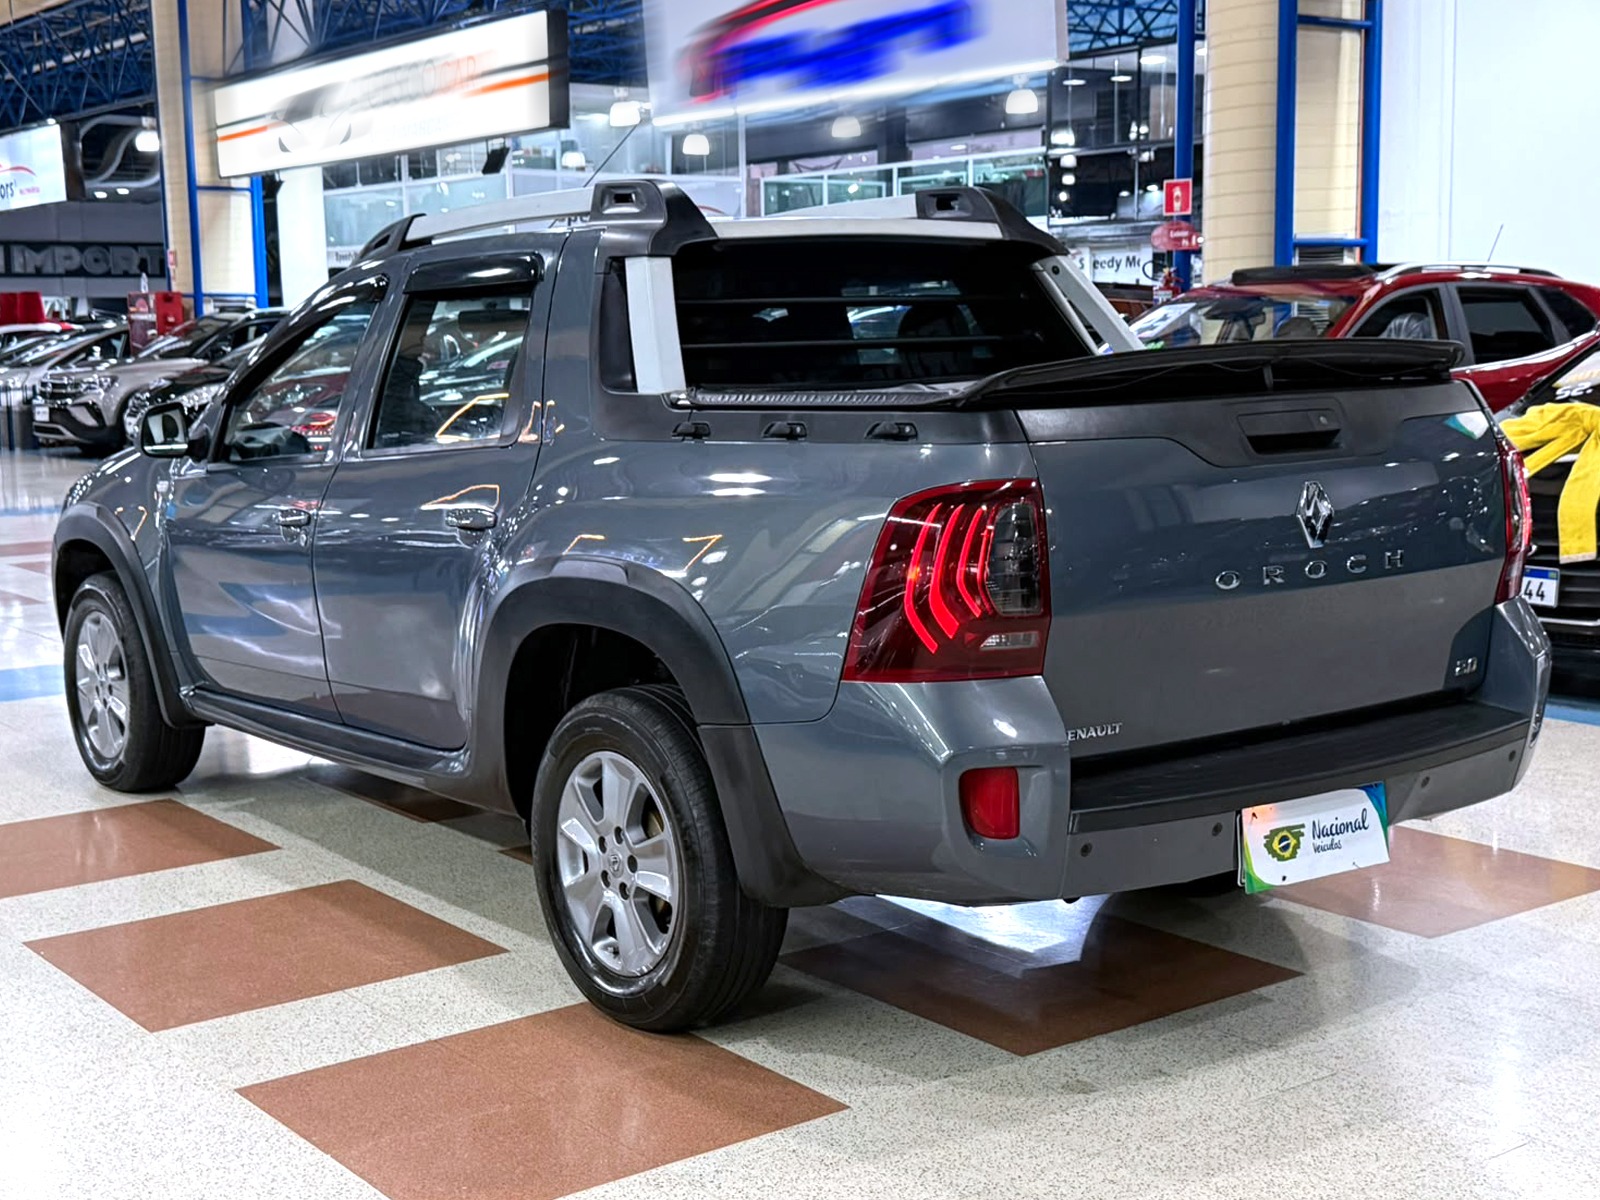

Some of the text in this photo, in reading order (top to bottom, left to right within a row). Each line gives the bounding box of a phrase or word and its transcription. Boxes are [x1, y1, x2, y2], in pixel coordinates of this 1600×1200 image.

[0, 182, 14, 199] ors
[12, 244, 164, 275] IMPORT
[1079, 255, 1122, 272] Seedy
[1215, 550, 1405, 590] OROCH
[1523, 580, 1545, 601] 44
[1067, 722, 1123, 741] ENAULT
[1312, 808, 1369, 840] Nacional
